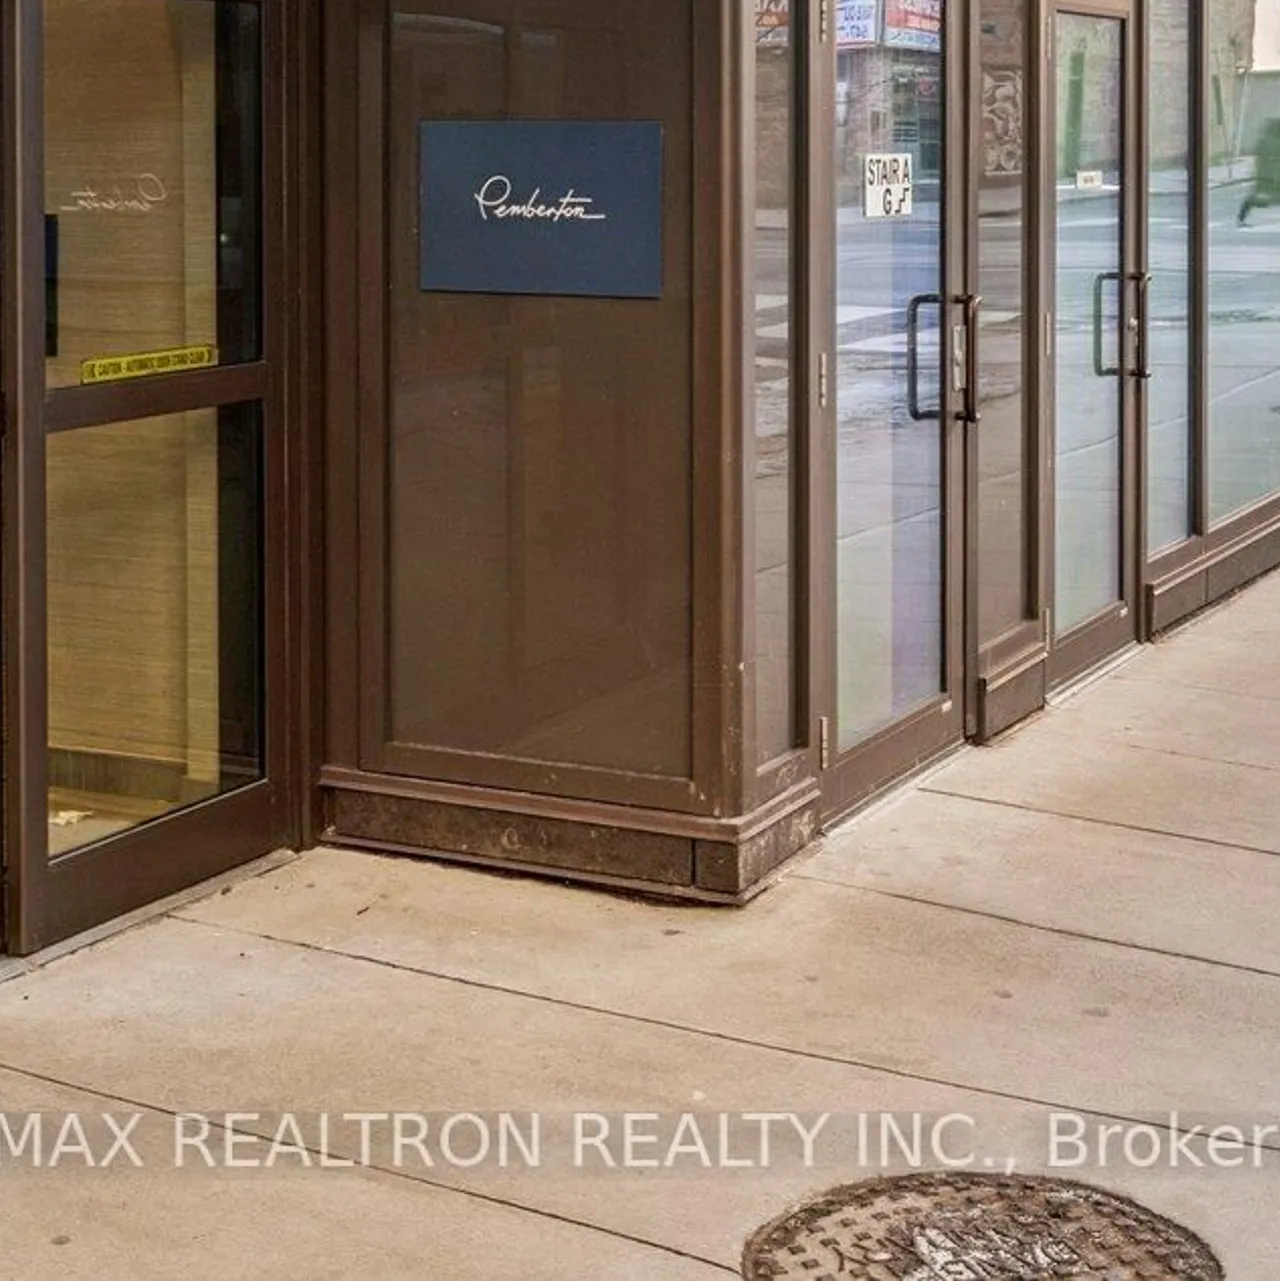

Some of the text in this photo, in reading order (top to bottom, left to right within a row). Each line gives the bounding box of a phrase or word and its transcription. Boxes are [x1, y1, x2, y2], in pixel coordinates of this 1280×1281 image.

[868, 158, 910, 186] STAIR A
[474, 175, 606, 222] Pemberton
[883, 188, 892, 216] G
